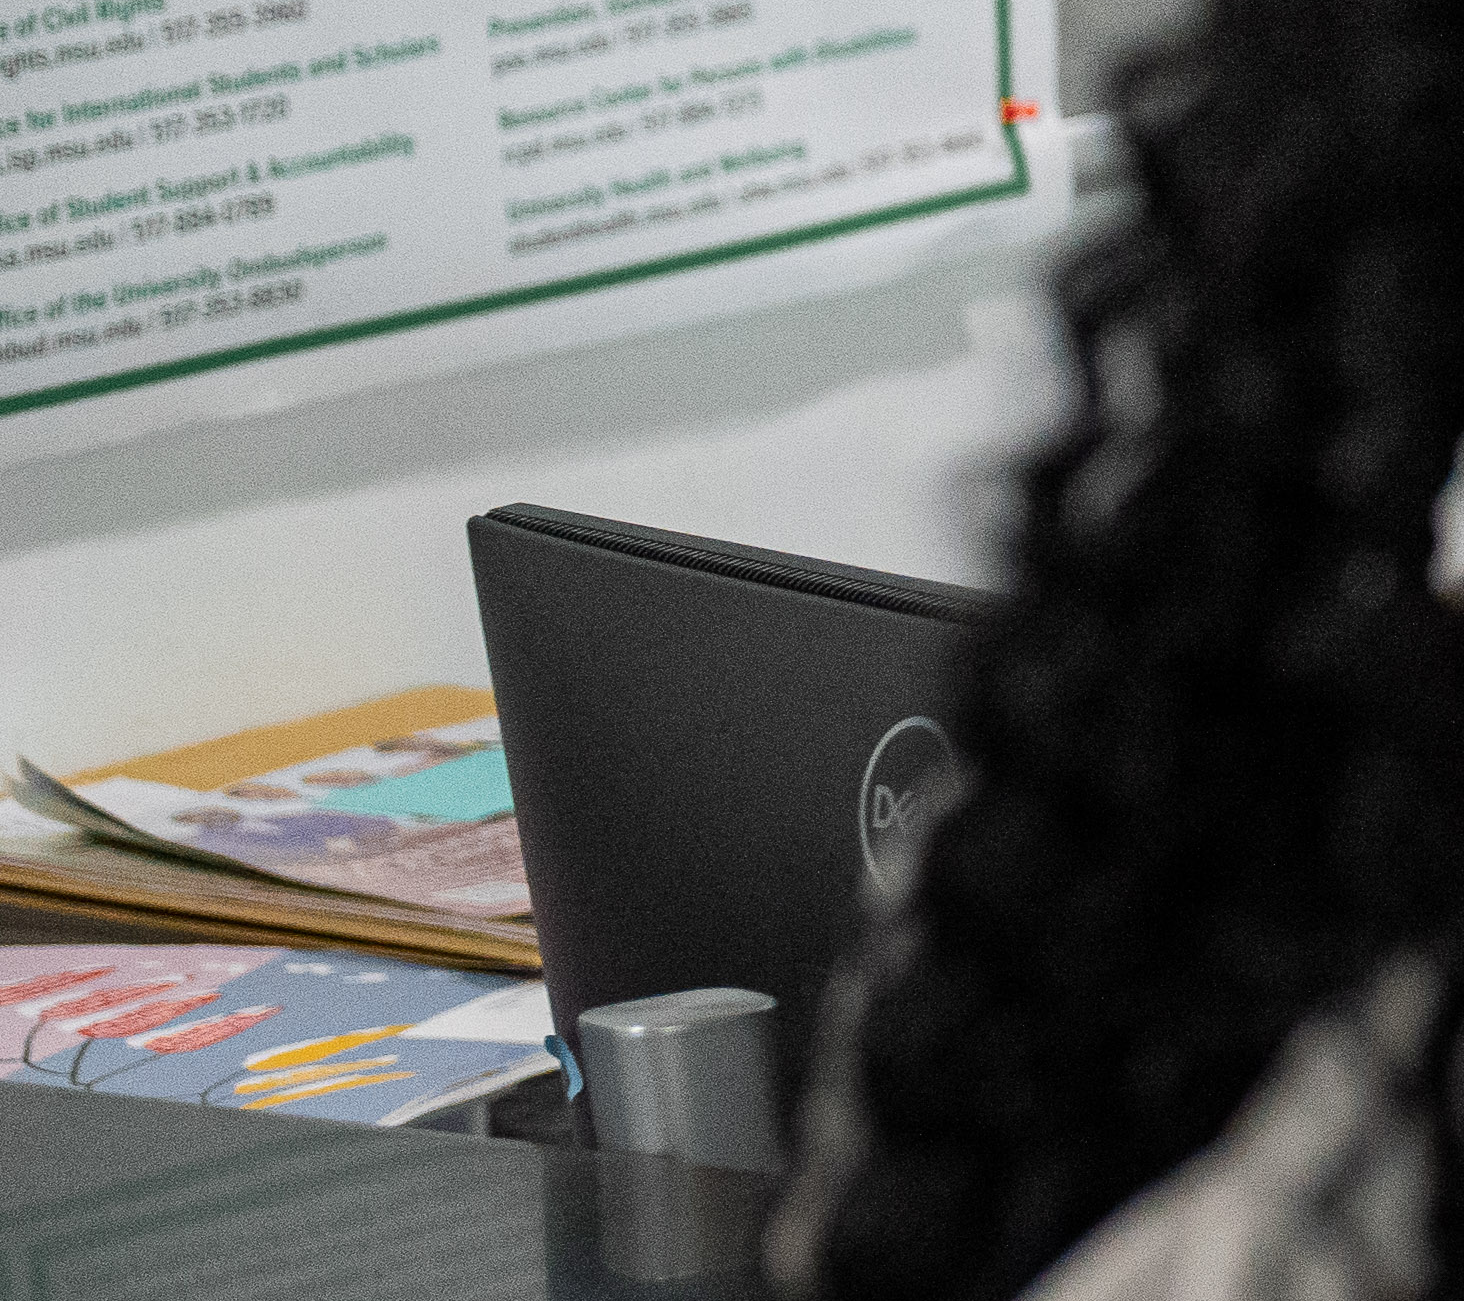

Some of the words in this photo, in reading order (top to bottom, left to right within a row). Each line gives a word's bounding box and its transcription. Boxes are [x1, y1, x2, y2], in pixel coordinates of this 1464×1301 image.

[12, 12, 40, 39] of
[40, 2, 92, 34] Civil
[24, 110, 57, 131] for
[61, 81, 203, 125] International
[206, 62, 303, 96] Students
[307, 51, 350, 79] and
[351, 37, 441, 70] Scholars
[35, 202, 62, 228] of
[64, 186, 151, 222] Student
[154, 167, 241, 204] Support
[245, 162, 262, 185] &
[266, 133, 415, 180] Accountability
[43, 295, 71, 321] of
[70, 291, 108, 315] the
[111, 266, 223, 307] University
